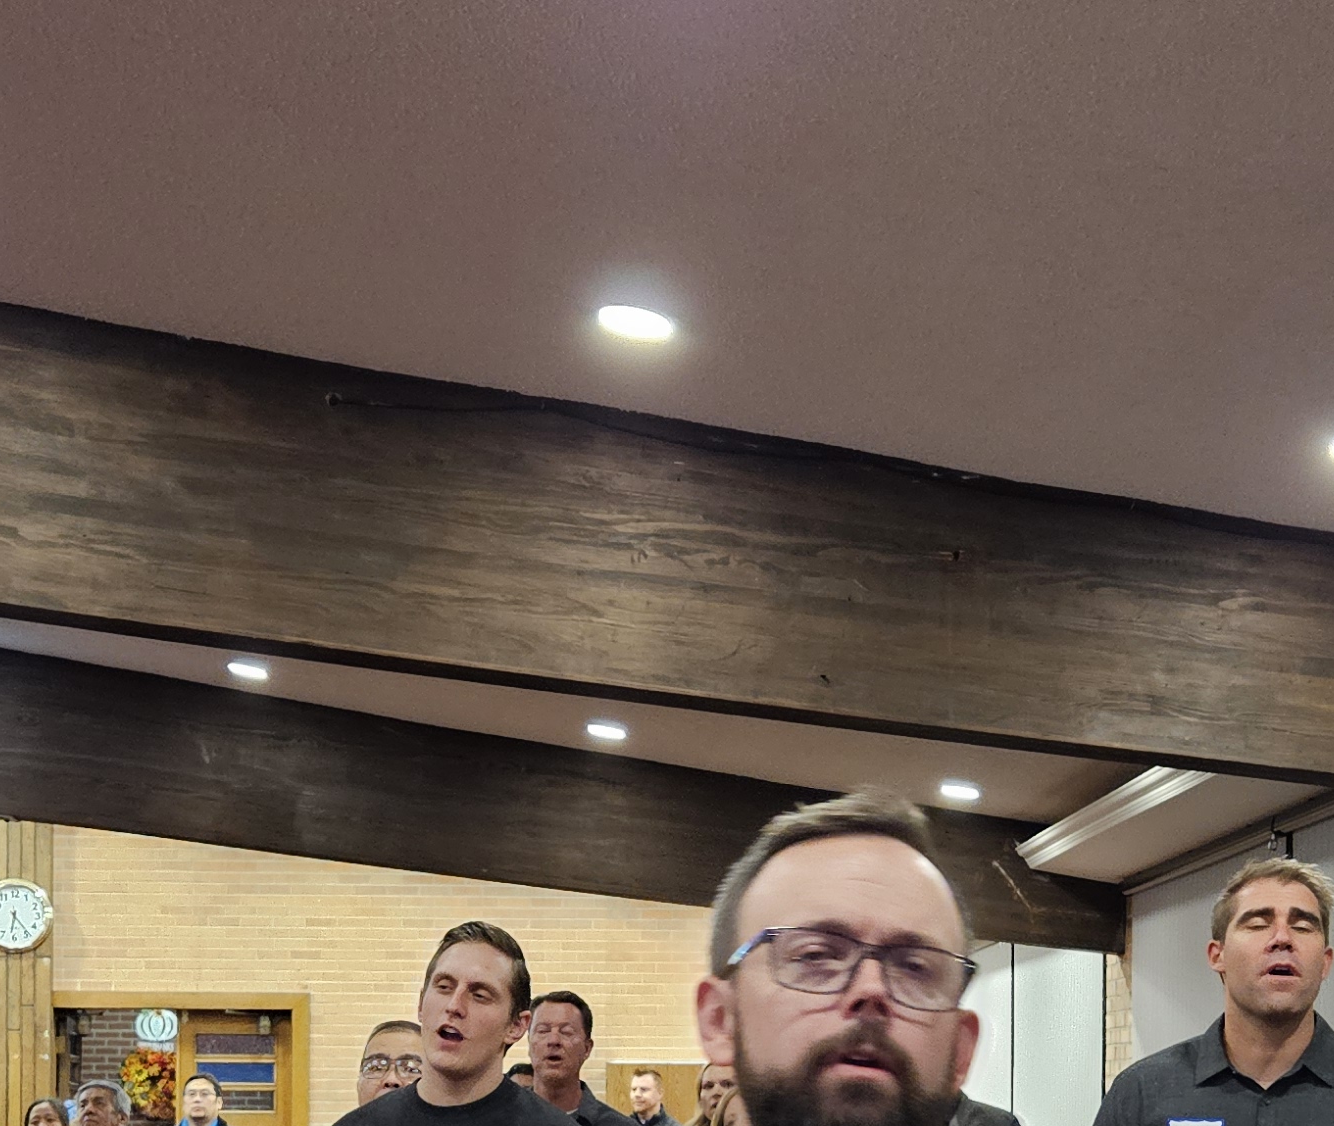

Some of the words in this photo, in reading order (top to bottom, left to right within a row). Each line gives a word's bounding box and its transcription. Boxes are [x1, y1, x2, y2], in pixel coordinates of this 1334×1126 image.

[0, 893, 7, 901] 11
[11, 889, 20, 898] 12
[35, 912, 41, 920] 3
[0, 931, 6, 939] 7
[12, 933, 17, 941] 6
[24, 930, 28, 938] 5
